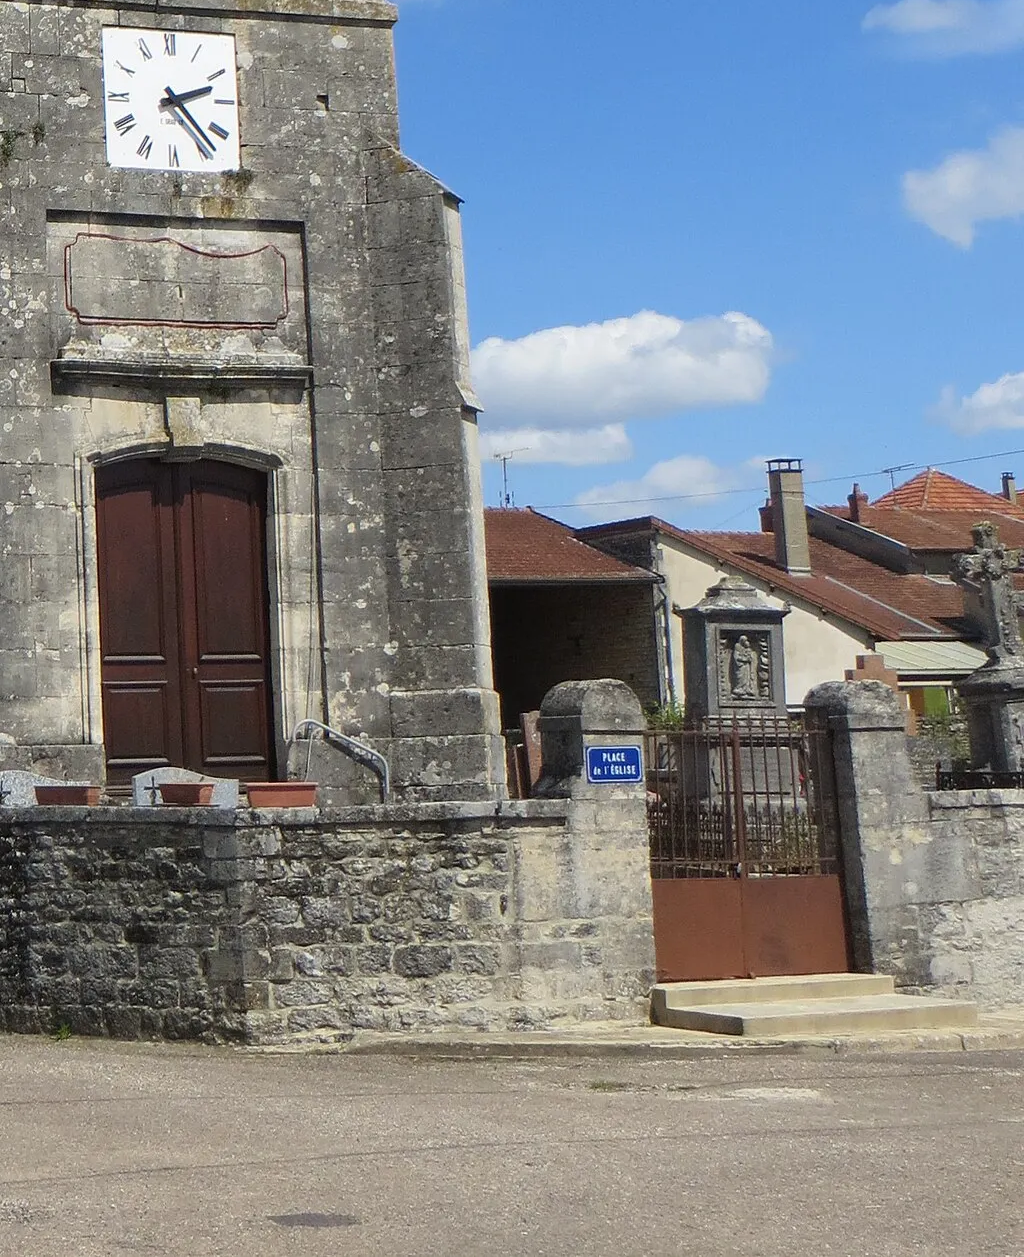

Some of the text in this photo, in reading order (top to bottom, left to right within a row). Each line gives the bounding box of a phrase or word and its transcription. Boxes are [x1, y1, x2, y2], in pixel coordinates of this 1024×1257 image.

[164, 33, 176, 56] XII
[191, 44, 202, 63] I
[114, 60, 136, 78] X
[206, 68, 226, 81] II
[108, 90, 130, 102] IX
[113, 113, 137, 136] VIII
[136, 134, 153, 160] VII
[168, 143, 180, 168] VI
[602, 752, 626, 762] PLACE
[593, 766, 602, 776] de
